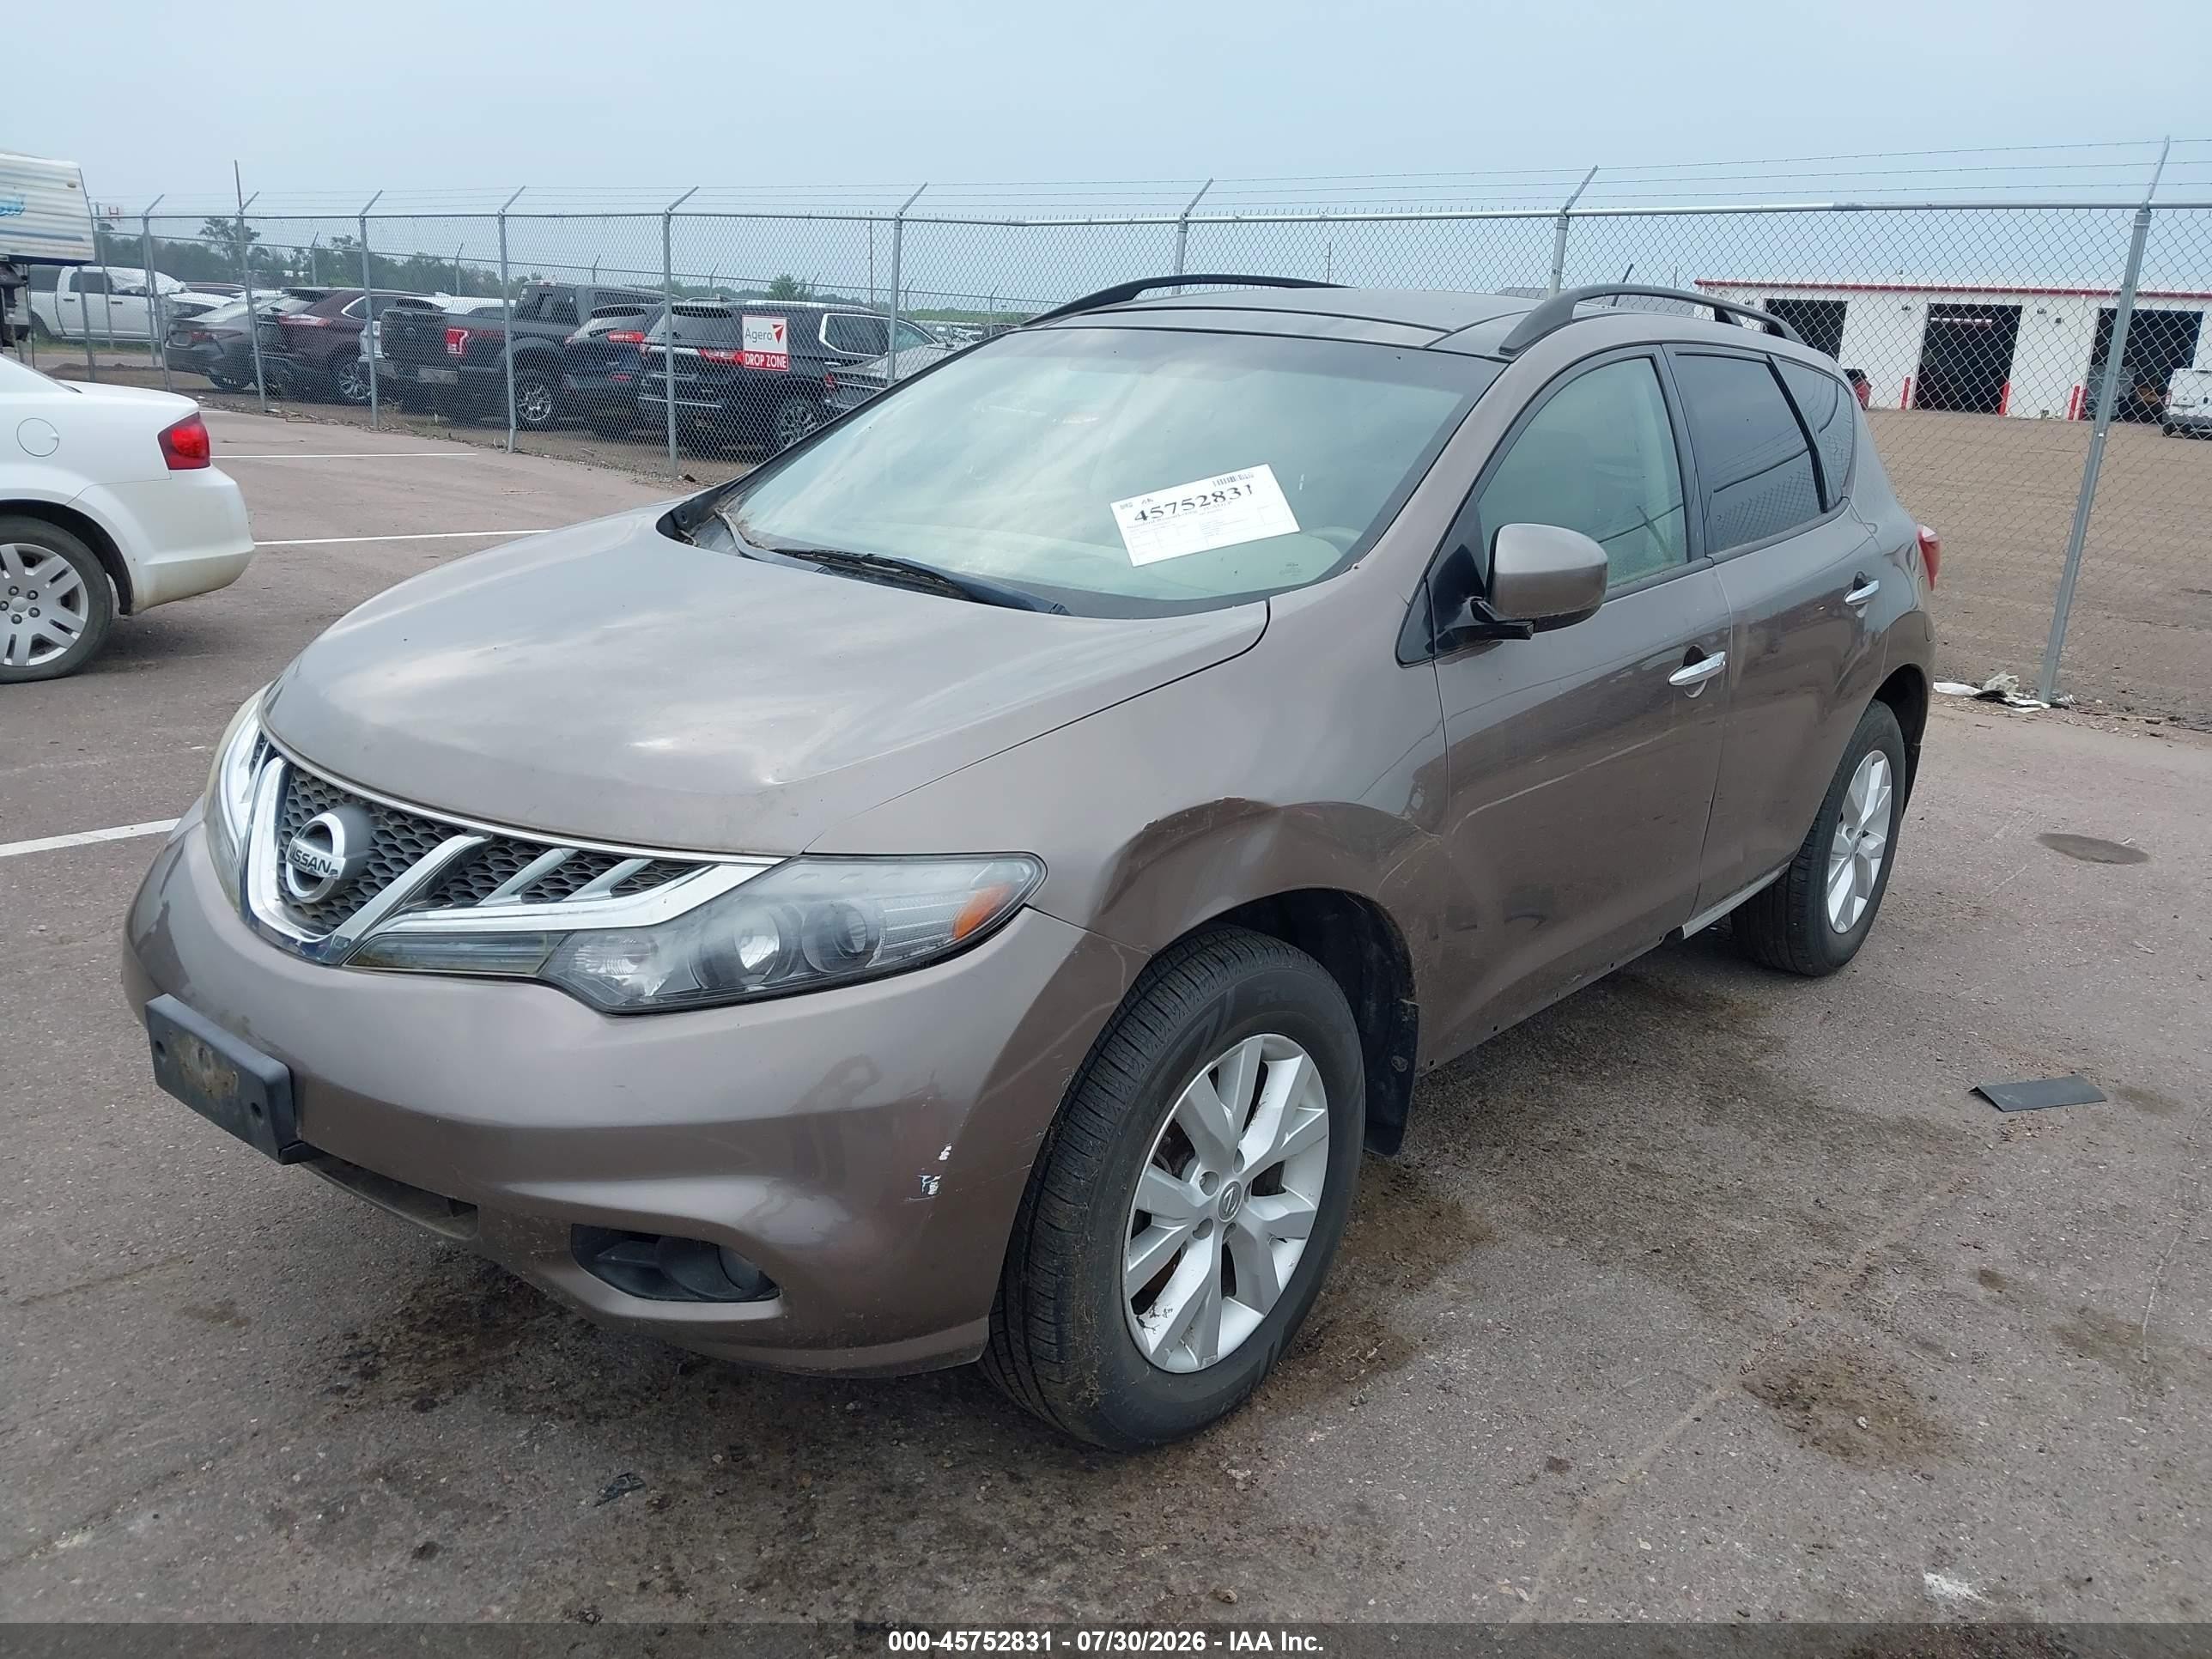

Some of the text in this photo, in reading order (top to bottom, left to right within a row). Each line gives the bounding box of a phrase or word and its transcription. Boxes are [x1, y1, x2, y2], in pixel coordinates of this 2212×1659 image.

[744, 327, 773, 343] Agero
[744, 353, 787, 368] DROP ZONE
[1134, 483, 1253, 521] 45752831
